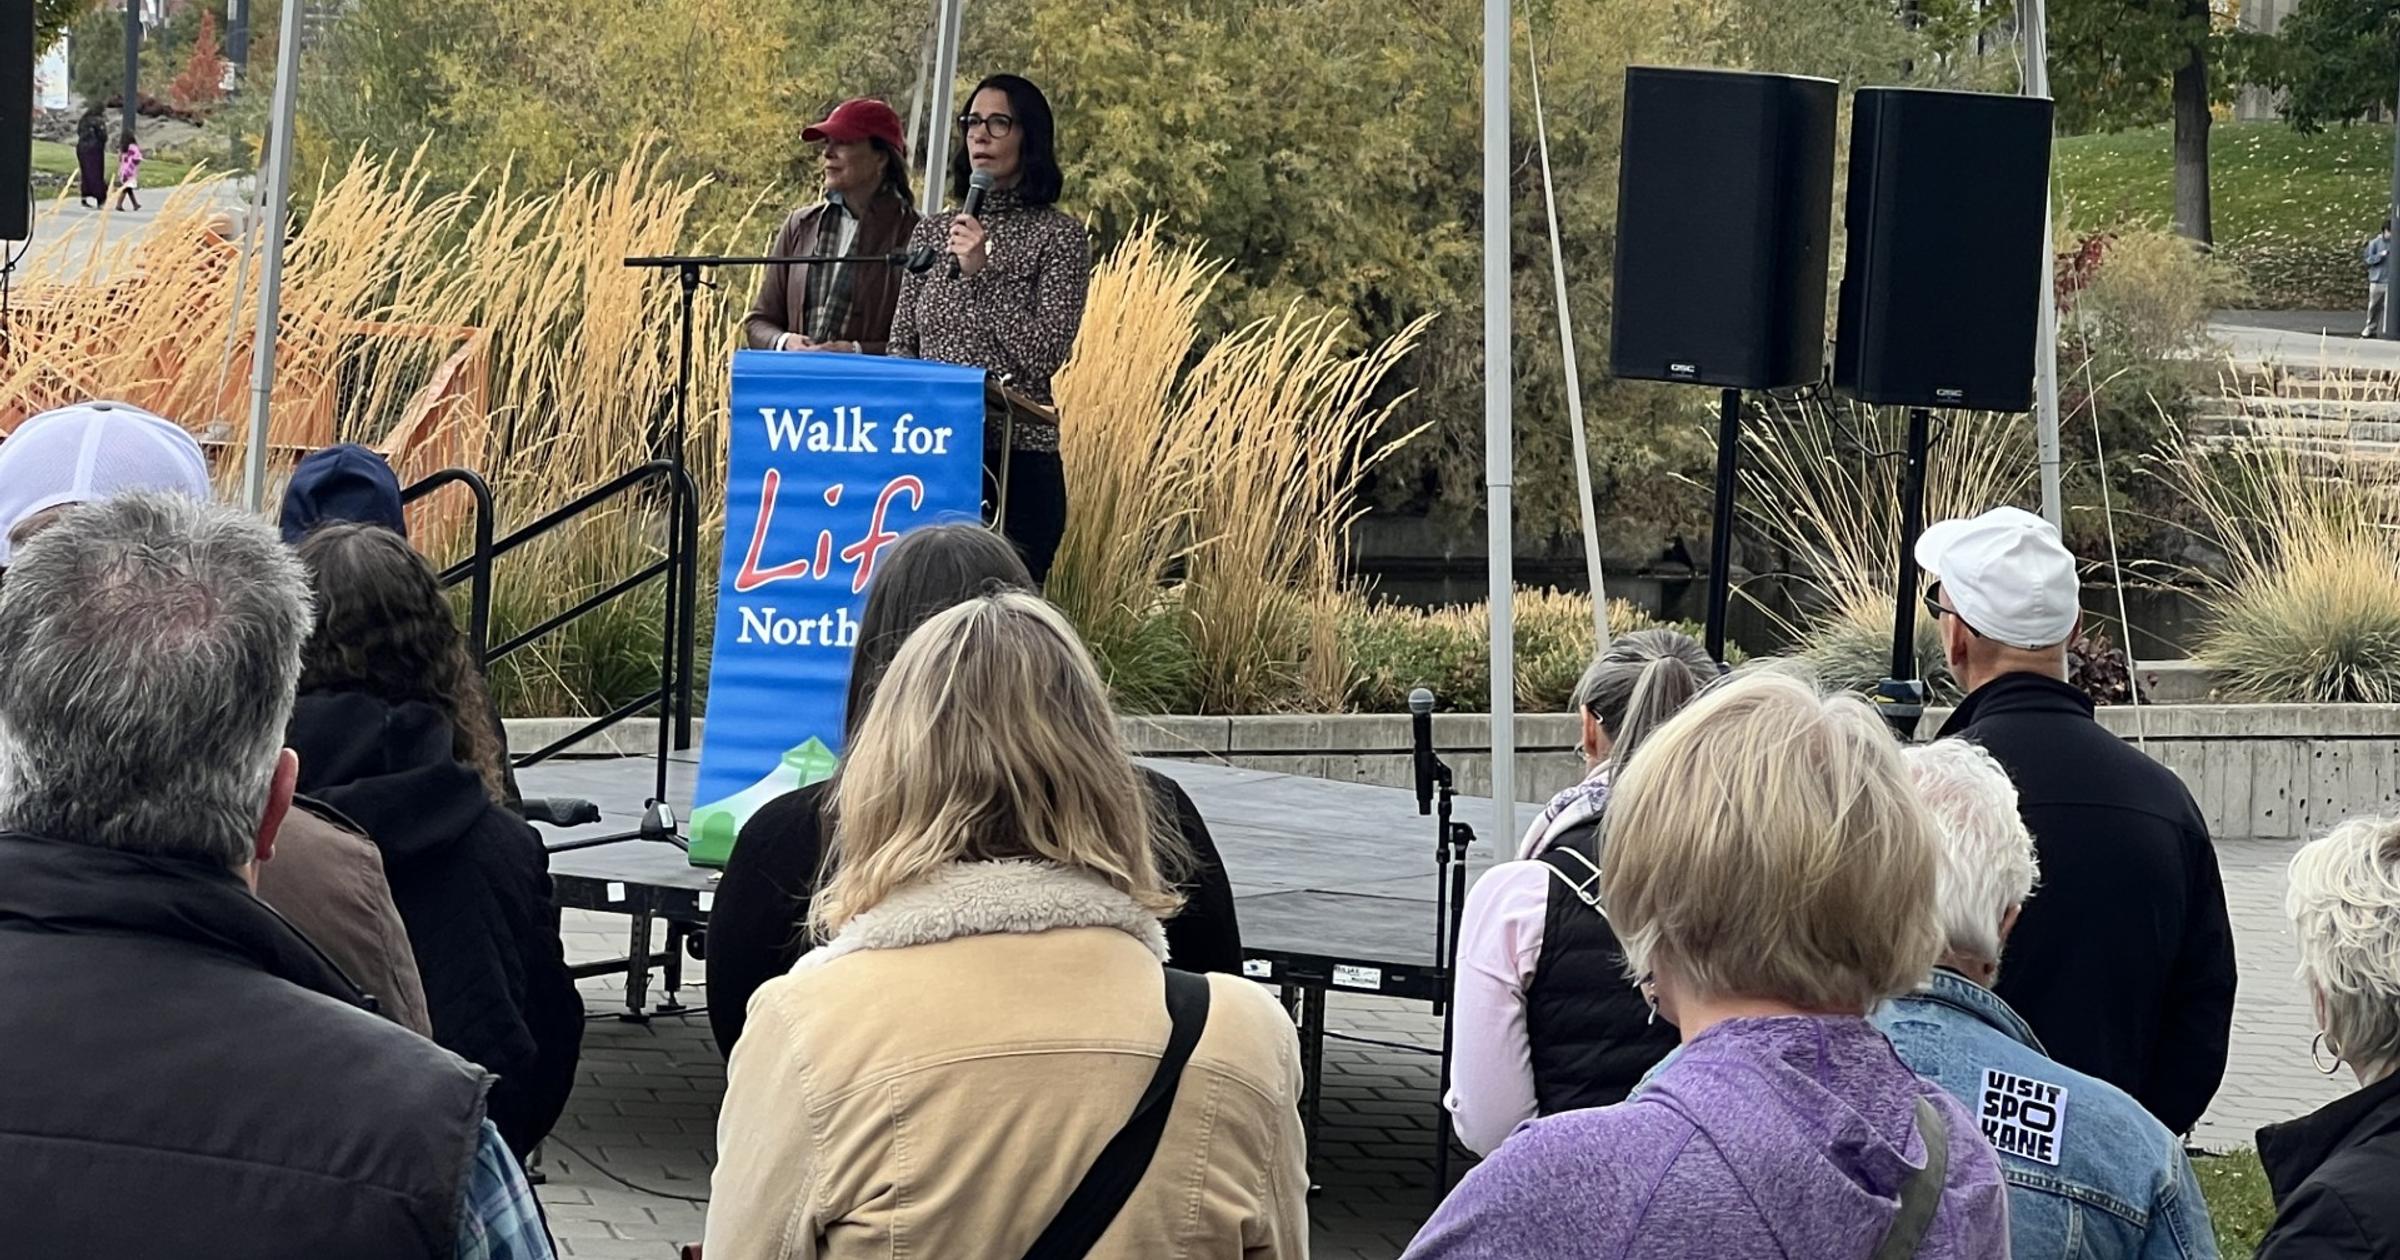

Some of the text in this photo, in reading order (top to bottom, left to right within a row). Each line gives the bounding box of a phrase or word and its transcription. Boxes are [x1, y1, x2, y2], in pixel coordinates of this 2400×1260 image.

[759, 406, 953, 454] Walk for
[734, 468, 924, 593] Lif
[1988, 1070, 2061, 1105] VISIT
[1983, 1090, 2056, 1133] SPO
[1981, 1118, 2053, 1162] KANE
